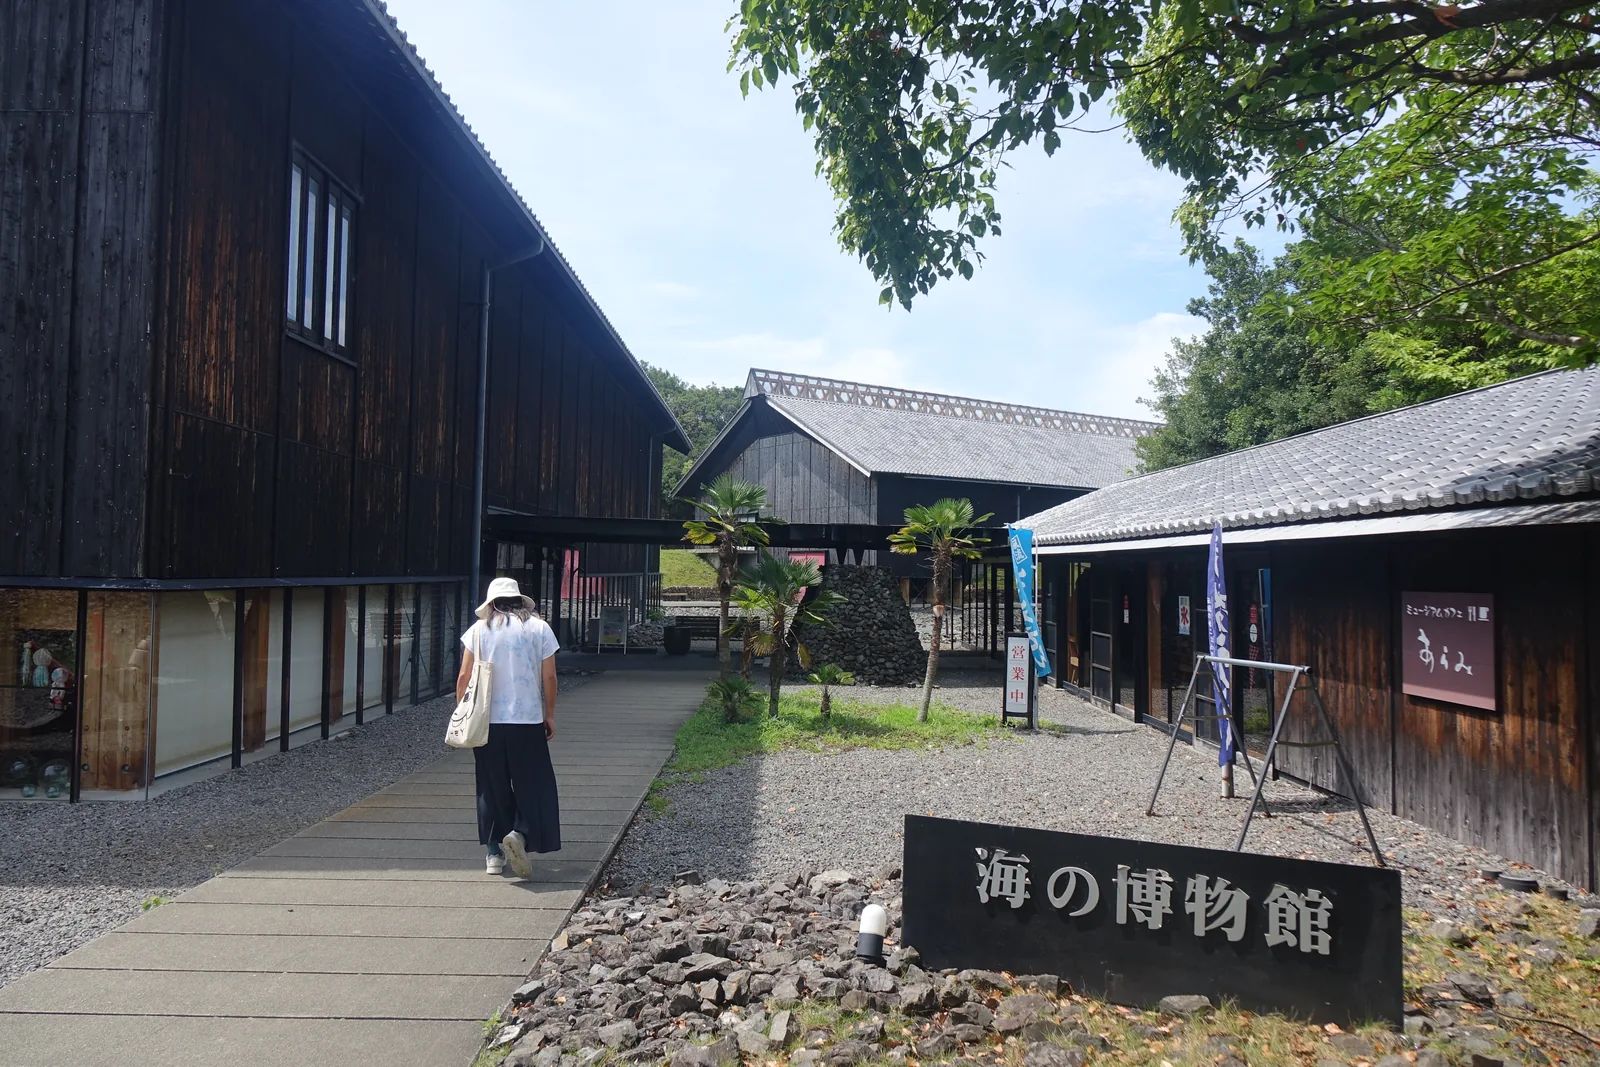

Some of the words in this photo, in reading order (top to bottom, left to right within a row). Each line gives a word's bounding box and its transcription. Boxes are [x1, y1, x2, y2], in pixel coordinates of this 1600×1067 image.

[1181, 606, 1190, 624] 氷
[1405, 604, 1463, 618] ミュージアムカフェ
[1010, 645, 1026, 702] 営業中
[975, 846, 1334, 955] 海の博物館
